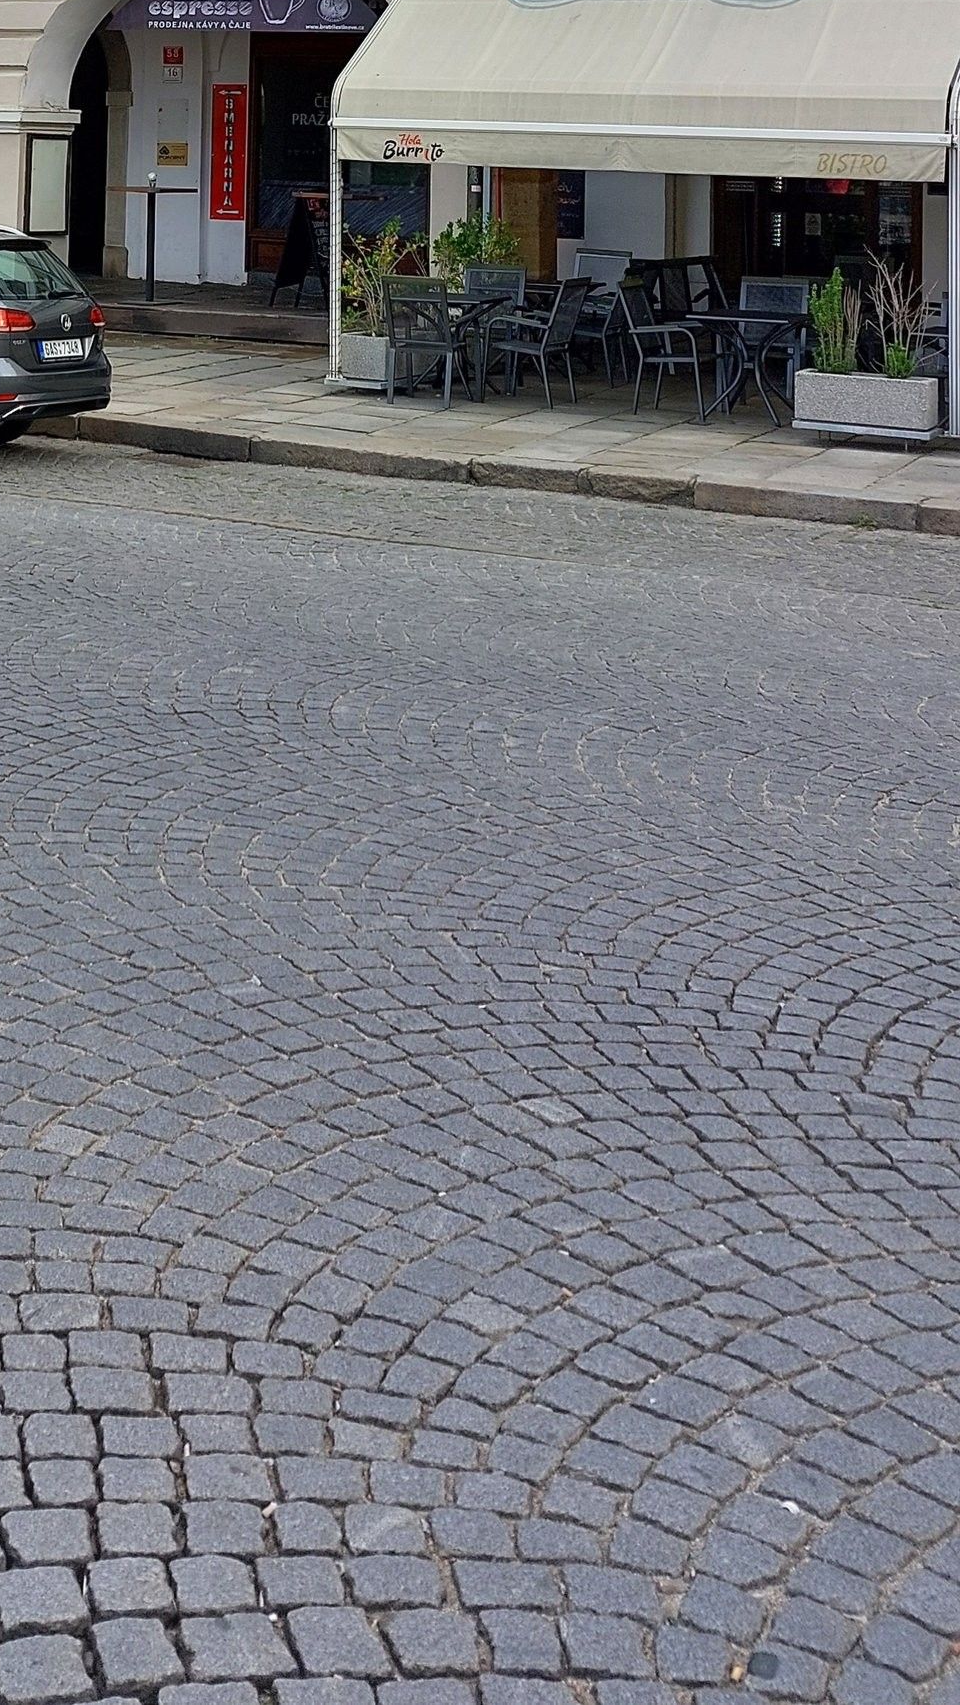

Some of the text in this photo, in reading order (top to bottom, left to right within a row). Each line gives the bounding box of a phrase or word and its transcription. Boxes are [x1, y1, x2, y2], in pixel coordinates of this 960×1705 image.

[148, 0, 253, 19] espresso
[148, 21, 194, 29] PRODEJNA
[195, 20, 219, 29] KÁVY
[228, 20, 251, 29] ČAJE
[167, 68, 178, 77] 16
[314, 93, 330, 108] ČE
[292, 110, 329, 126] PRAŽ
[399, 134, 422, 145] Hola
[383, 140, 445, 162] Burrito
[817, 153, 887, 175] BISTRO
